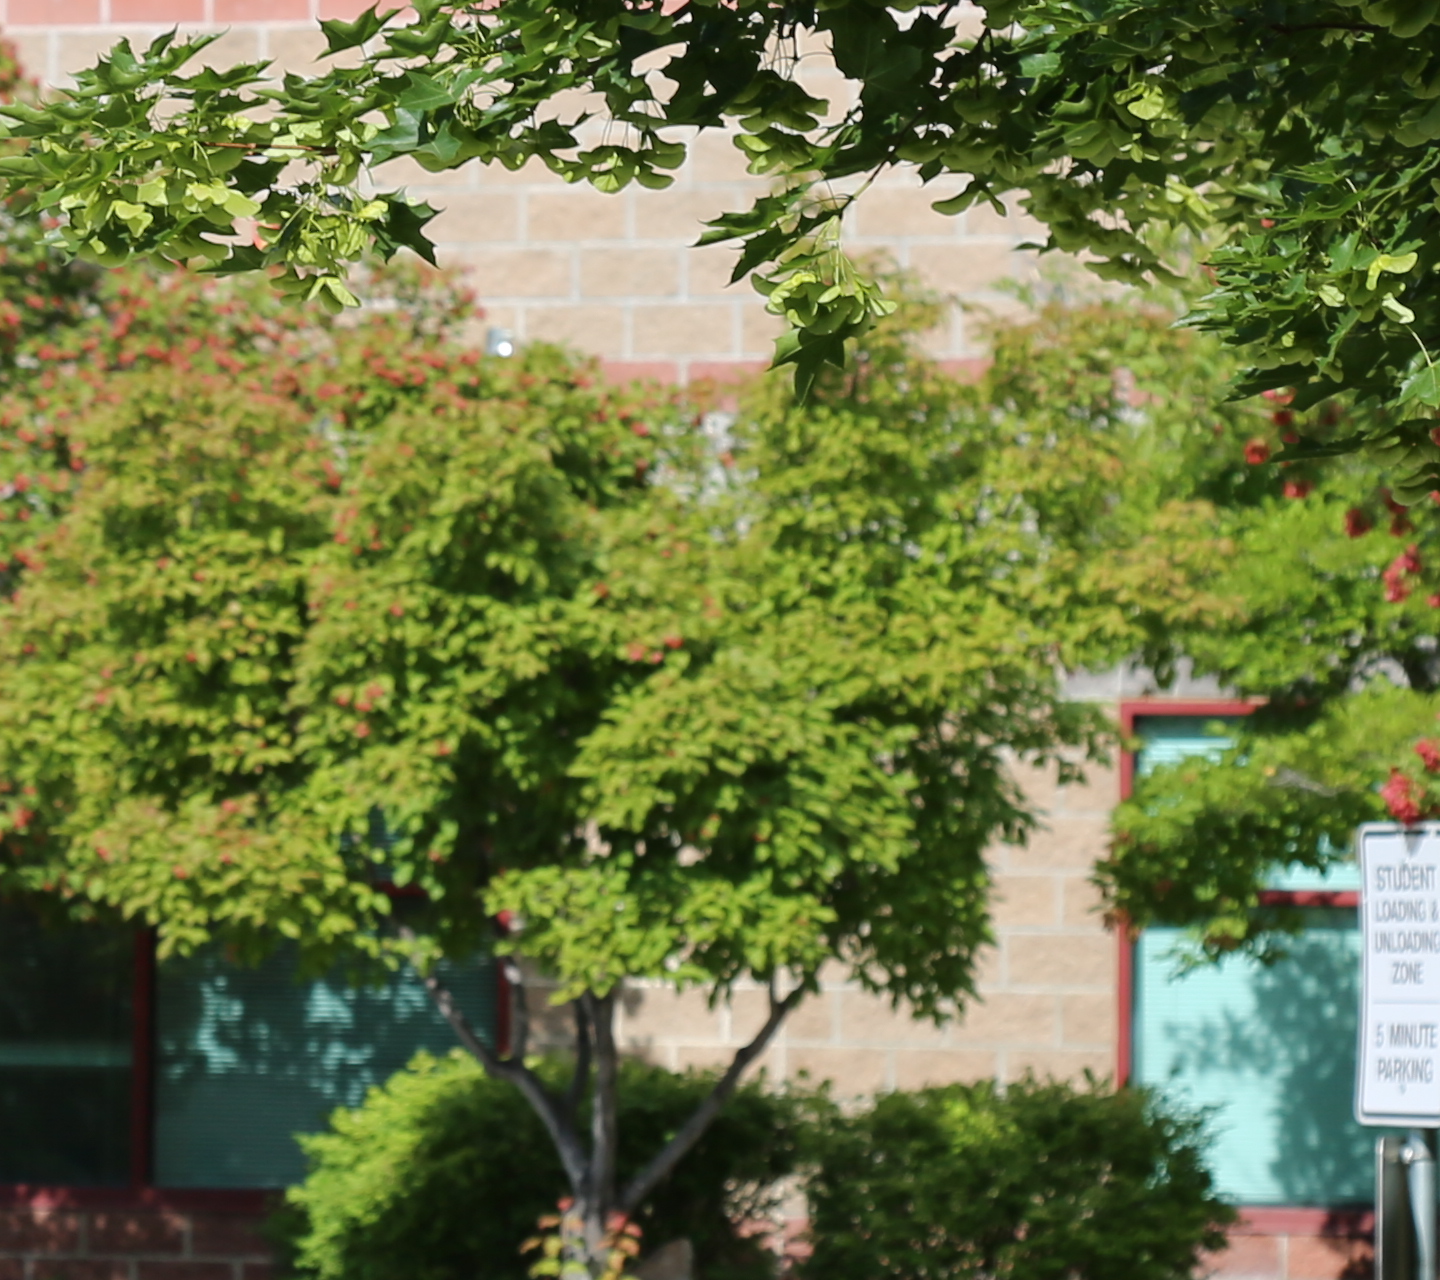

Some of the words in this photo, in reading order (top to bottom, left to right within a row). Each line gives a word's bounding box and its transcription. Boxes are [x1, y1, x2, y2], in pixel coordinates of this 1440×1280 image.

[1376, 865, 1437, 891] STUDENT
[1375, 899, 1426, 922] LOADING
[1391, 961, 1424, 985] ZONE
[1375, 1023, 1385, 1049] 5
[1389, 1023, 1438, 1049] MINUTE
[1377, 1058, 1434, 1084] PARKING
